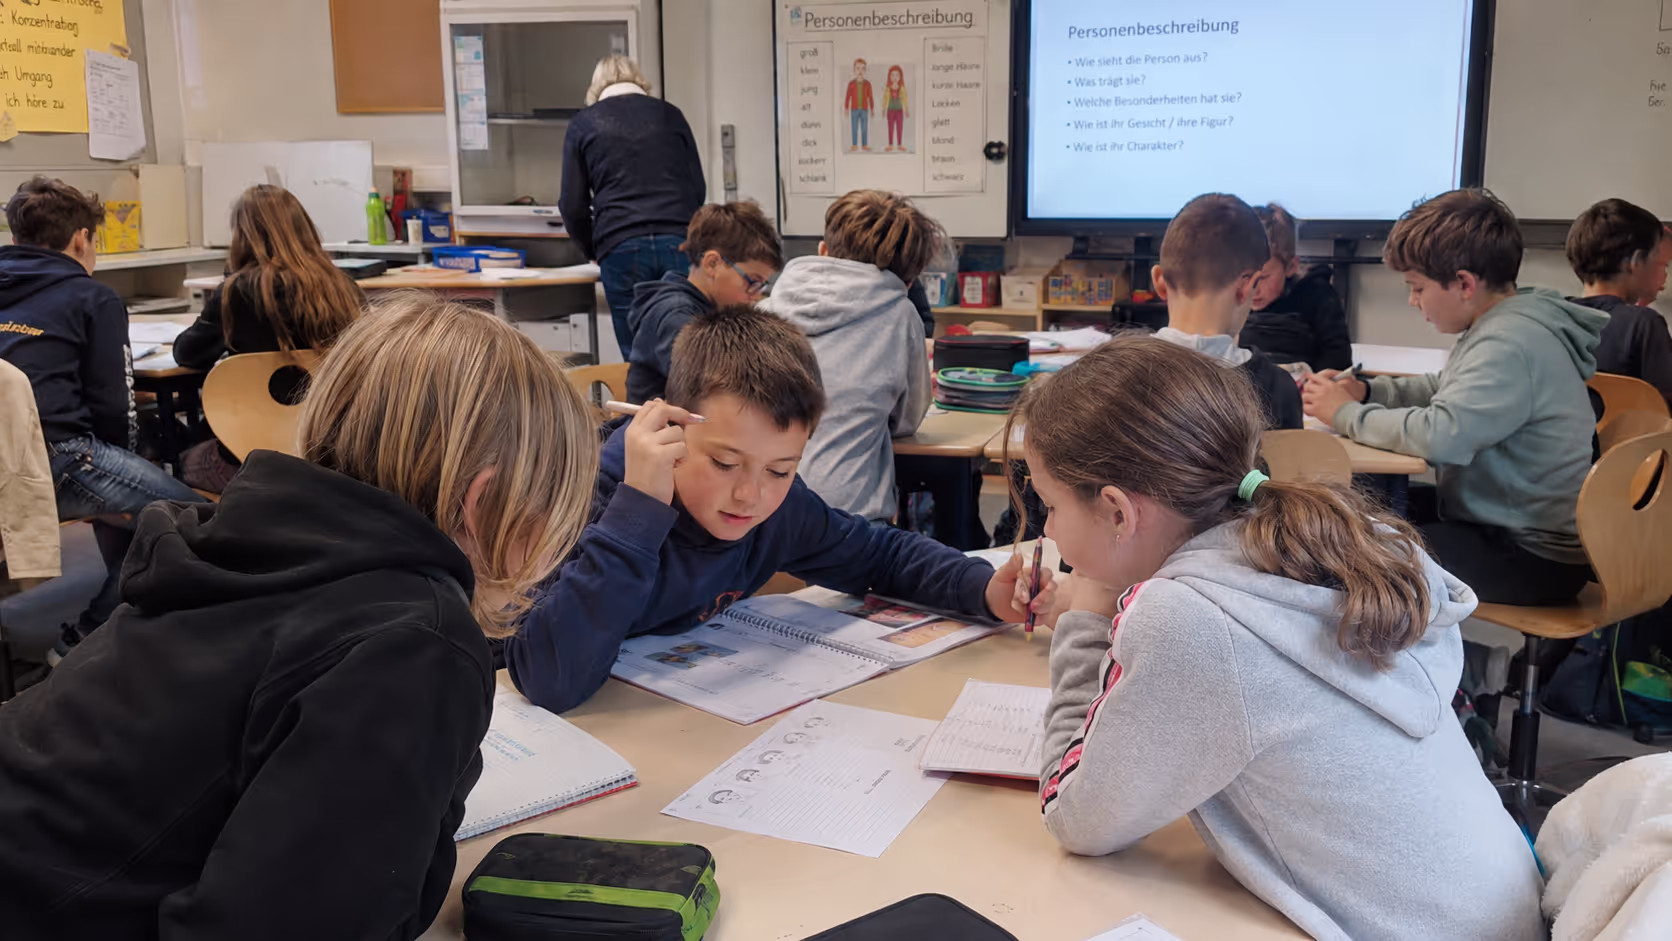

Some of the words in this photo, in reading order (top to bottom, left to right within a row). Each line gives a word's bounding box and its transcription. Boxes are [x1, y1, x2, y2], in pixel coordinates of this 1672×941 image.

[804, 9, 974, 29] Personenbeschreibung
[1068, 18, 1240, 39] Personenbeschreibung
[1075, 57, 1095, 67] Wie
[1097, 54, 1123, 67] sieht
[1125, 53, 1142, 65] die
[1144, 54, 1180, 65] Person
[1183, 52, 1208, 63] aus?
[14, 65, 53, 89] Umgang
[1074, 77, 1096, 88] Was
[1099, 75, 1123, 88] trägt
[1126, 74, 1147, 86] sie?
[53, 99, 65, 109] zu
[1074, 97, 1112, 108] Welche
[1114, 94, 1197, 107] Besonderheiten
[1200, 93, 1218, 104] hat
[1220, 92, 1242, 104] sie?
[1073, 119, 1094, 130] Wie
[1096, 118, 1108, 130] ist
[1111, 117, 1124, 129] ihr
[1127, 117, 1166, 129] Gesicht
[1177, 116, 1198, 127] ihre
[1200, 116, 1234, 129] Figur?
[1073, 142, 1093, 153] Wie
[1095, 141, 1107, 152] ist
[1110, 141, 1124, 152] ihr
[1127, 139, 1185, 152] Charakter?
